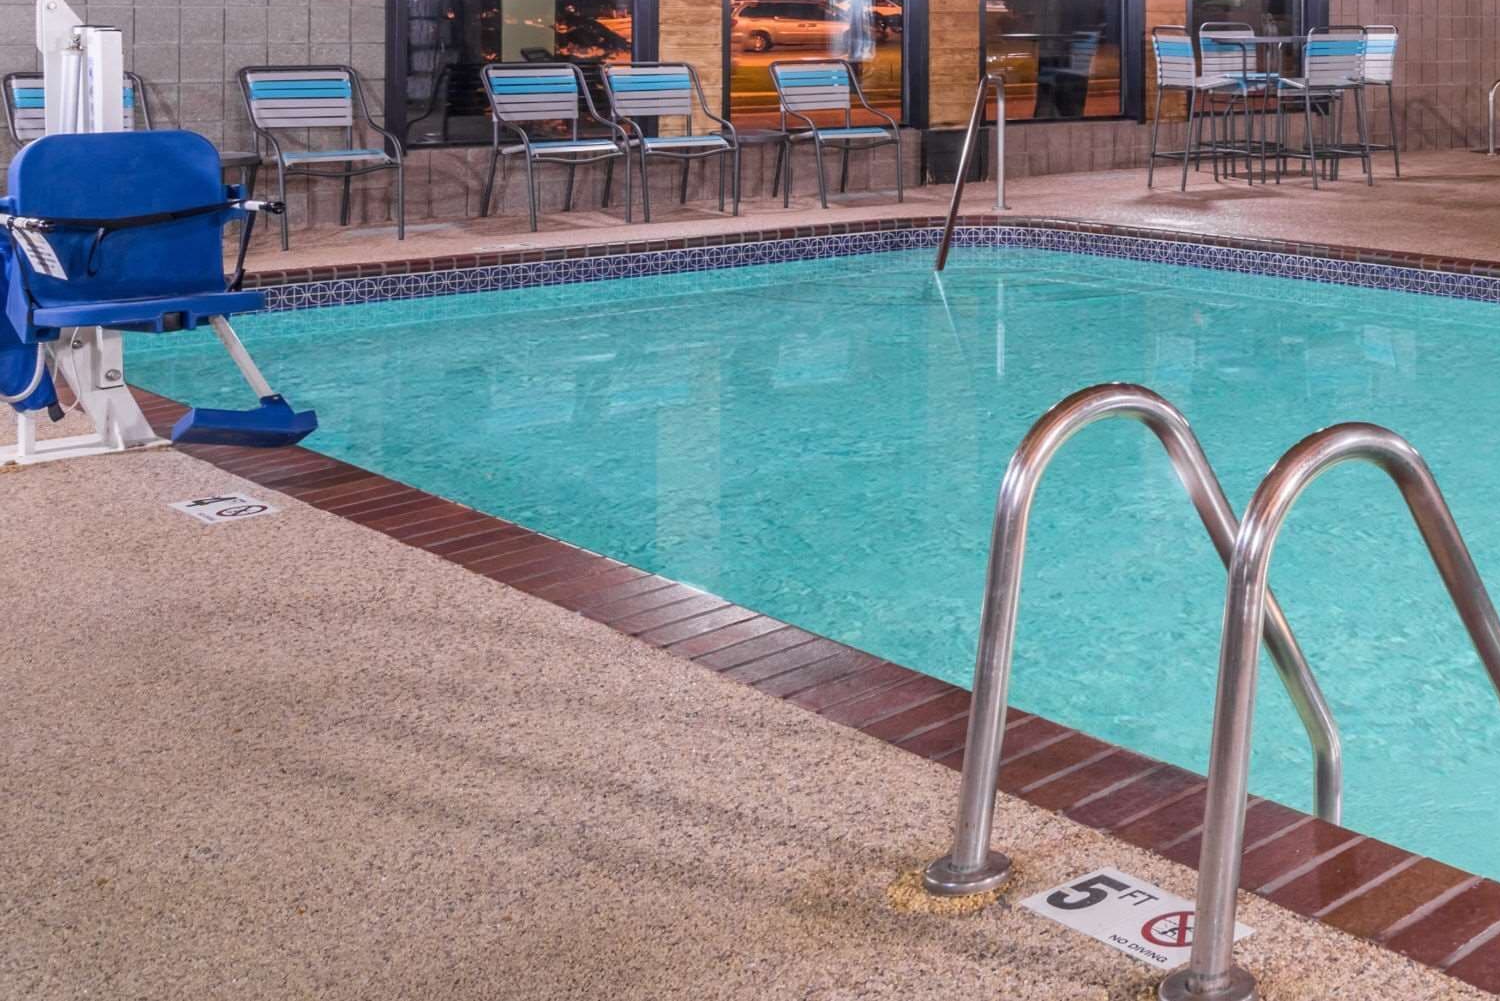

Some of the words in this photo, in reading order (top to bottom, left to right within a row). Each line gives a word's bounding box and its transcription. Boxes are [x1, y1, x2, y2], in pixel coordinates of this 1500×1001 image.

[1046, 874, 1131, 910] 5
[1117, 889, 1159, 906] FT
[1108, 934, 1129, 945] NO
[1127, 943, 1168, 963] DIVING
